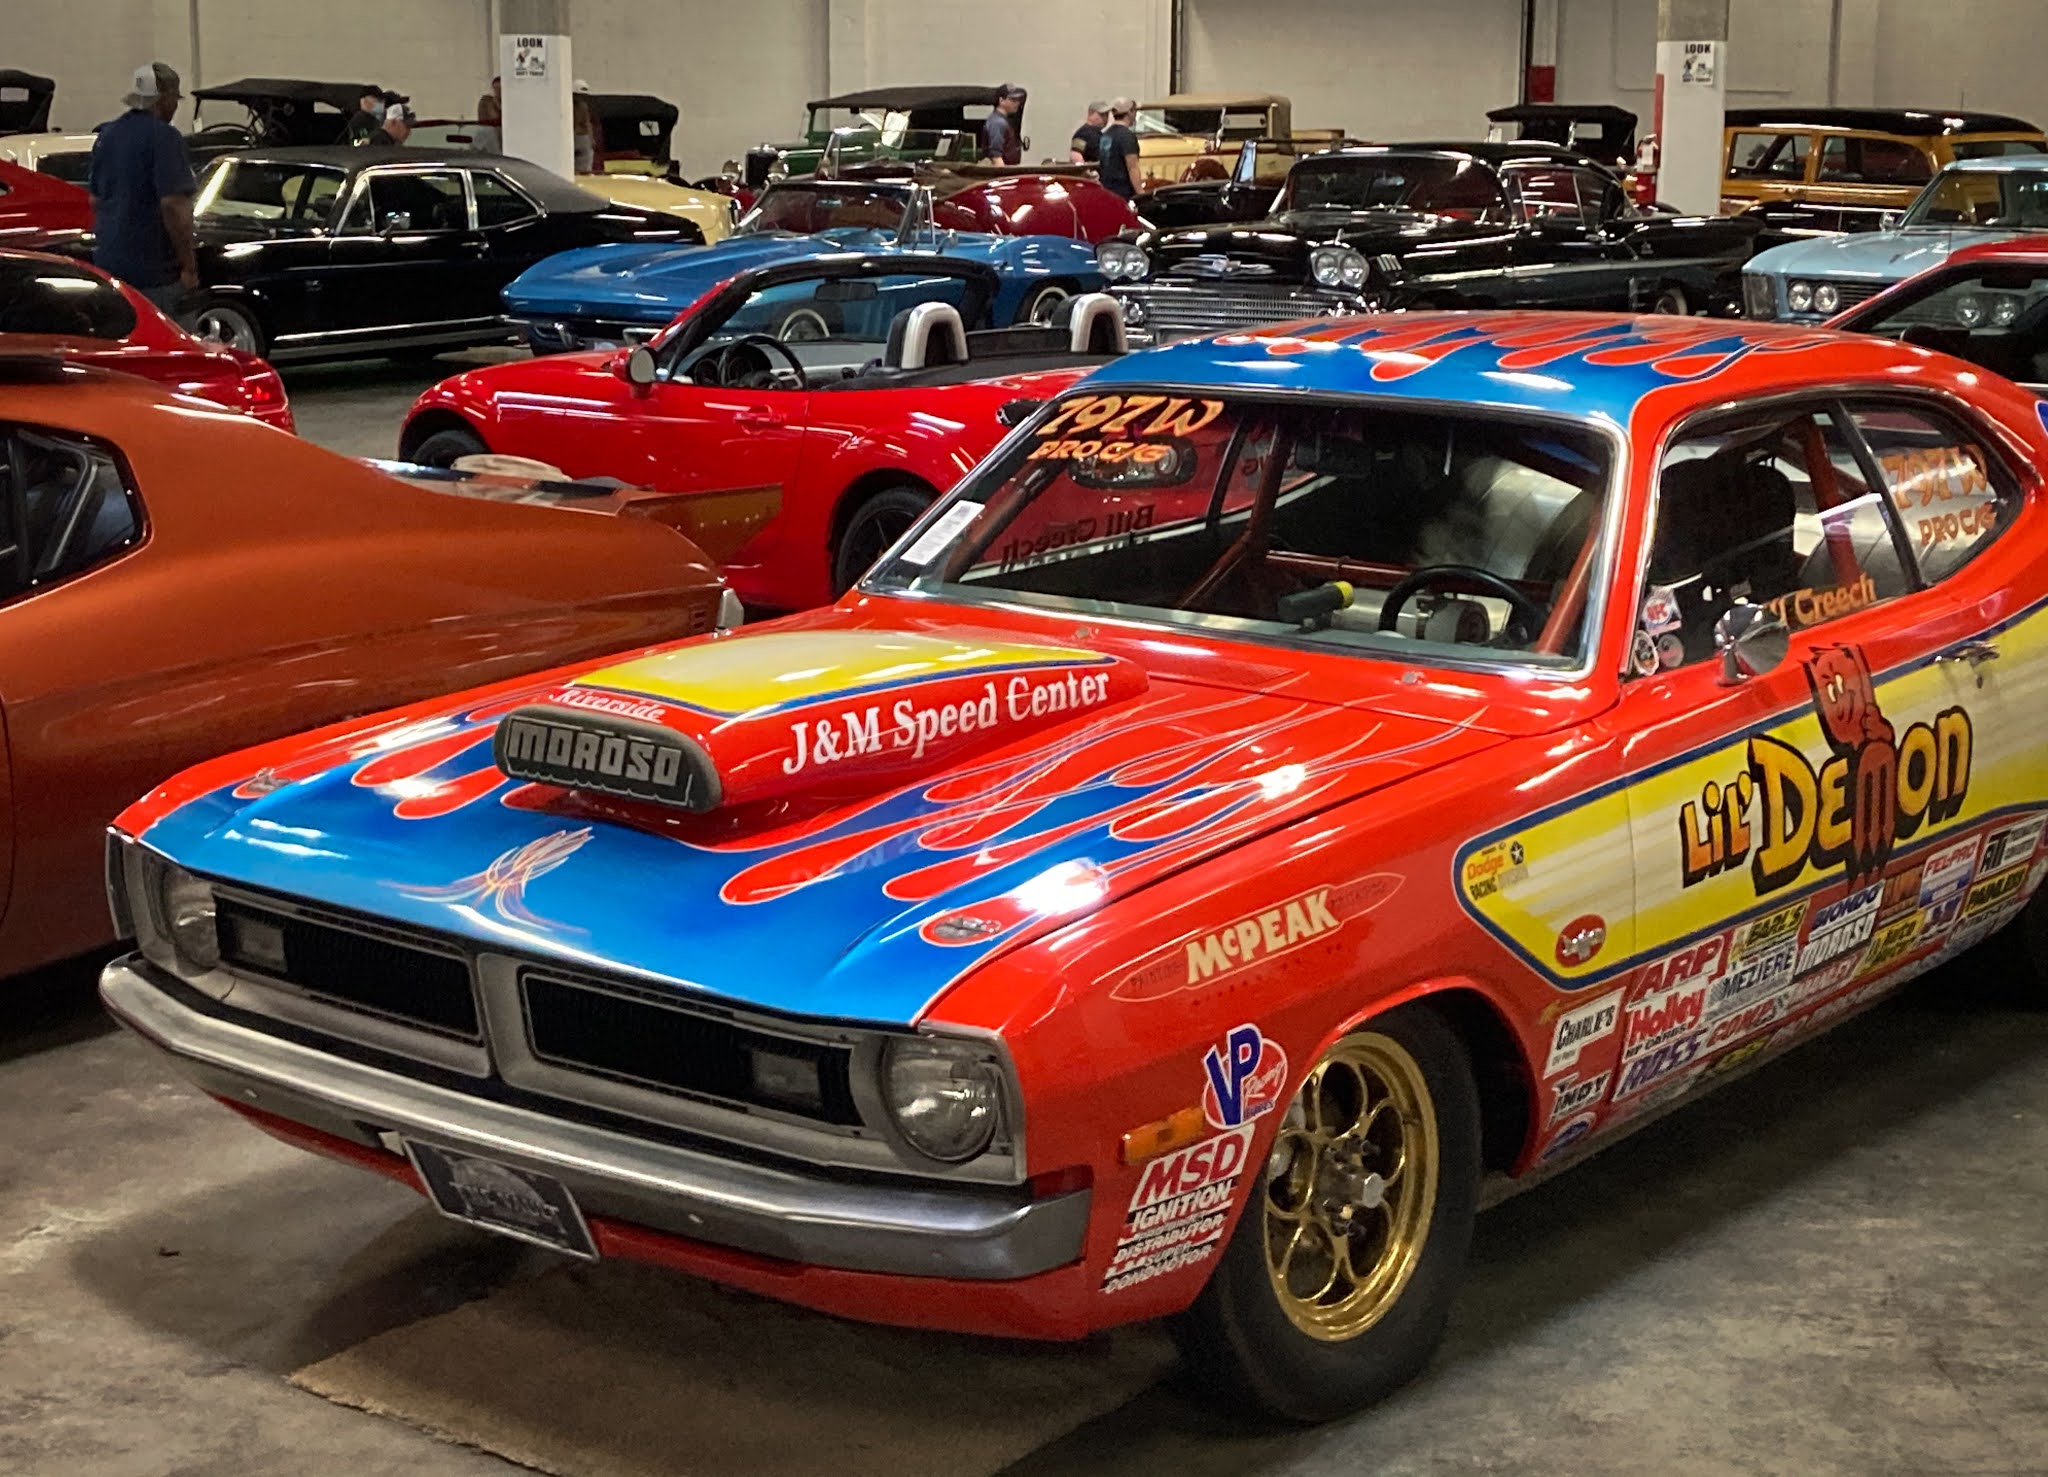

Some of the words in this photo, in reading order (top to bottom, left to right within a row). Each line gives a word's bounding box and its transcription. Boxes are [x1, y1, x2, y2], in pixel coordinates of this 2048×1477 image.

[517, 37, 543, 48] LOOK
[1685, 43, 1711, 54] LOOK
[1035, 395, 1225, 437] 797W
[1795, 572, 1877, 625] Creech
[549, 686, 666, 723] Riverside
[782, 707, 883, 775] J&M
[893, 682, 998, 759] Speed
[1006, 671, 1109, 721] Center
[1467, 855, 1504, 880] Dodge
[1629, 938, 1721, 1003] ARP
[1628, 988, 1706, 1048] Holley
[1204, 1024, 1262, 1126] VP
[1136, 1132, 1245, 1208] MSD
[1131, 1177, 1233, 1233] IGNITION
